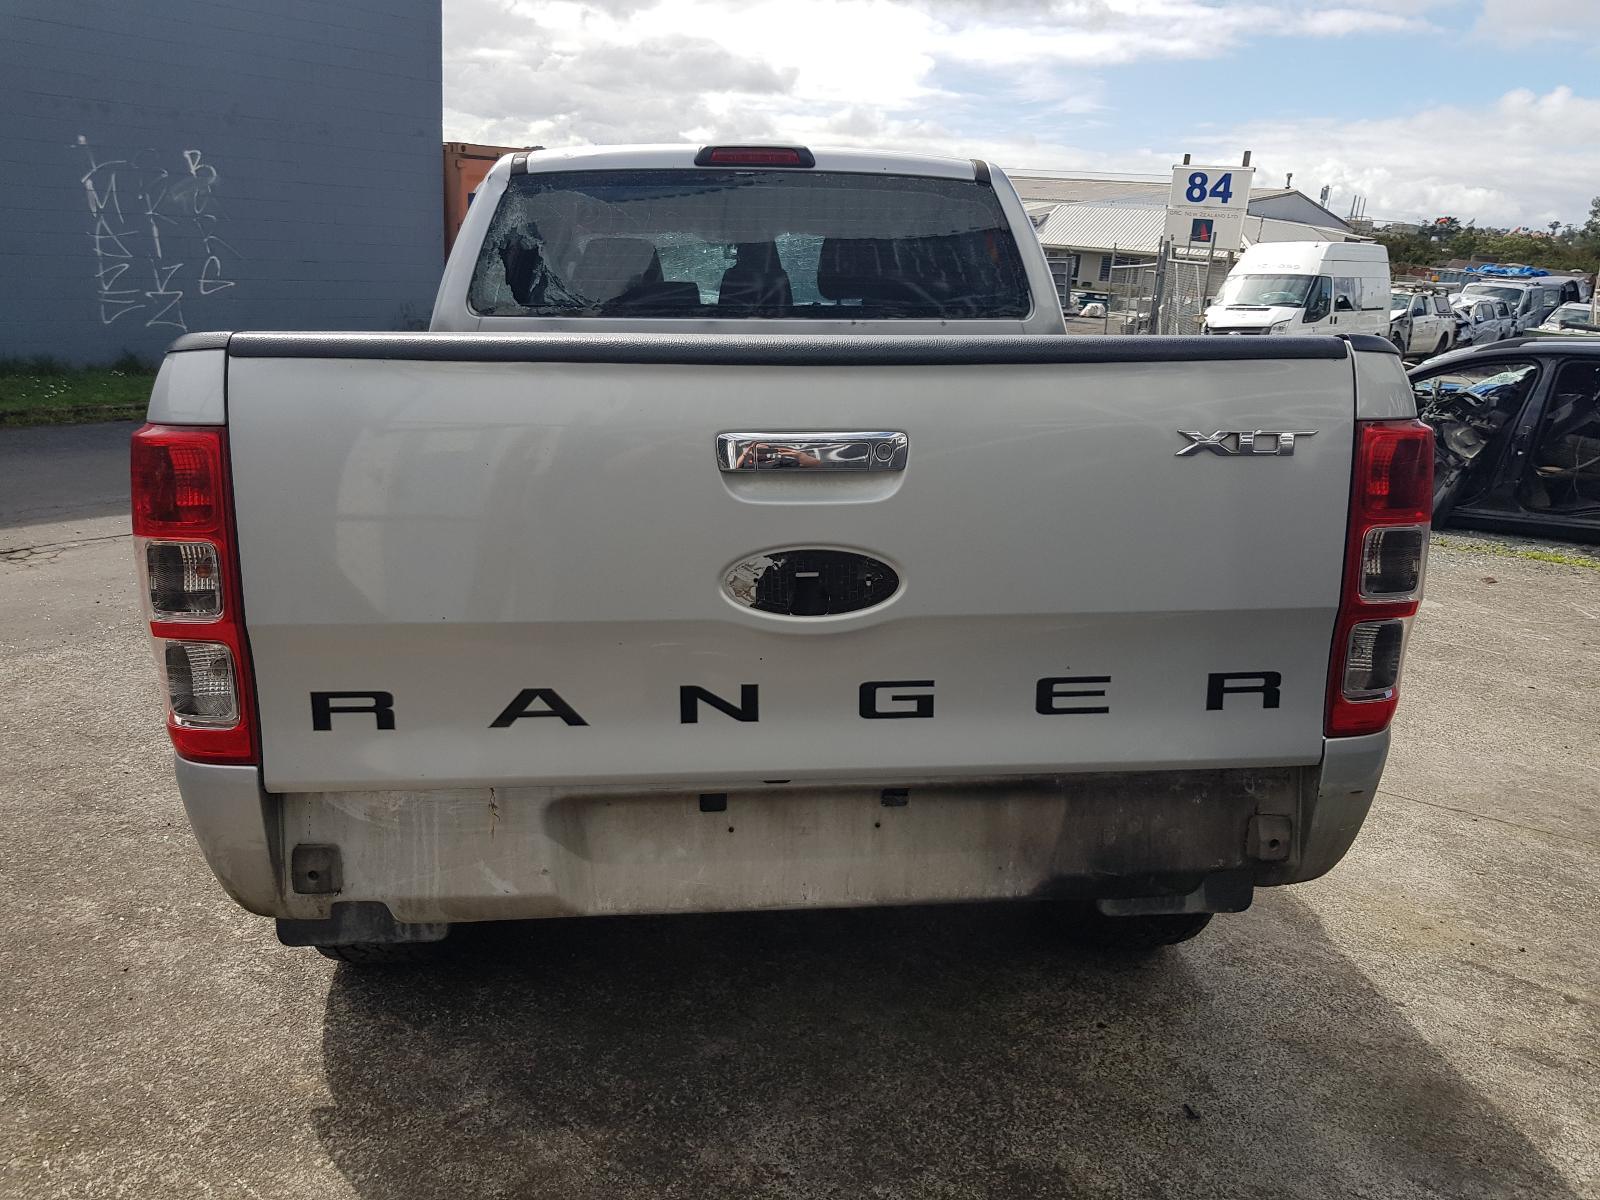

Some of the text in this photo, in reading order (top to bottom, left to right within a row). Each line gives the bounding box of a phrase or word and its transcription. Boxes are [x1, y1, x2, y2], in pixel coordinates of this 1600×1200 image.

[1185, 171, 1233, 204] 84
[1175, 430, 1319, 456] XLT
[310, 670, 1282, 731] RANGER
